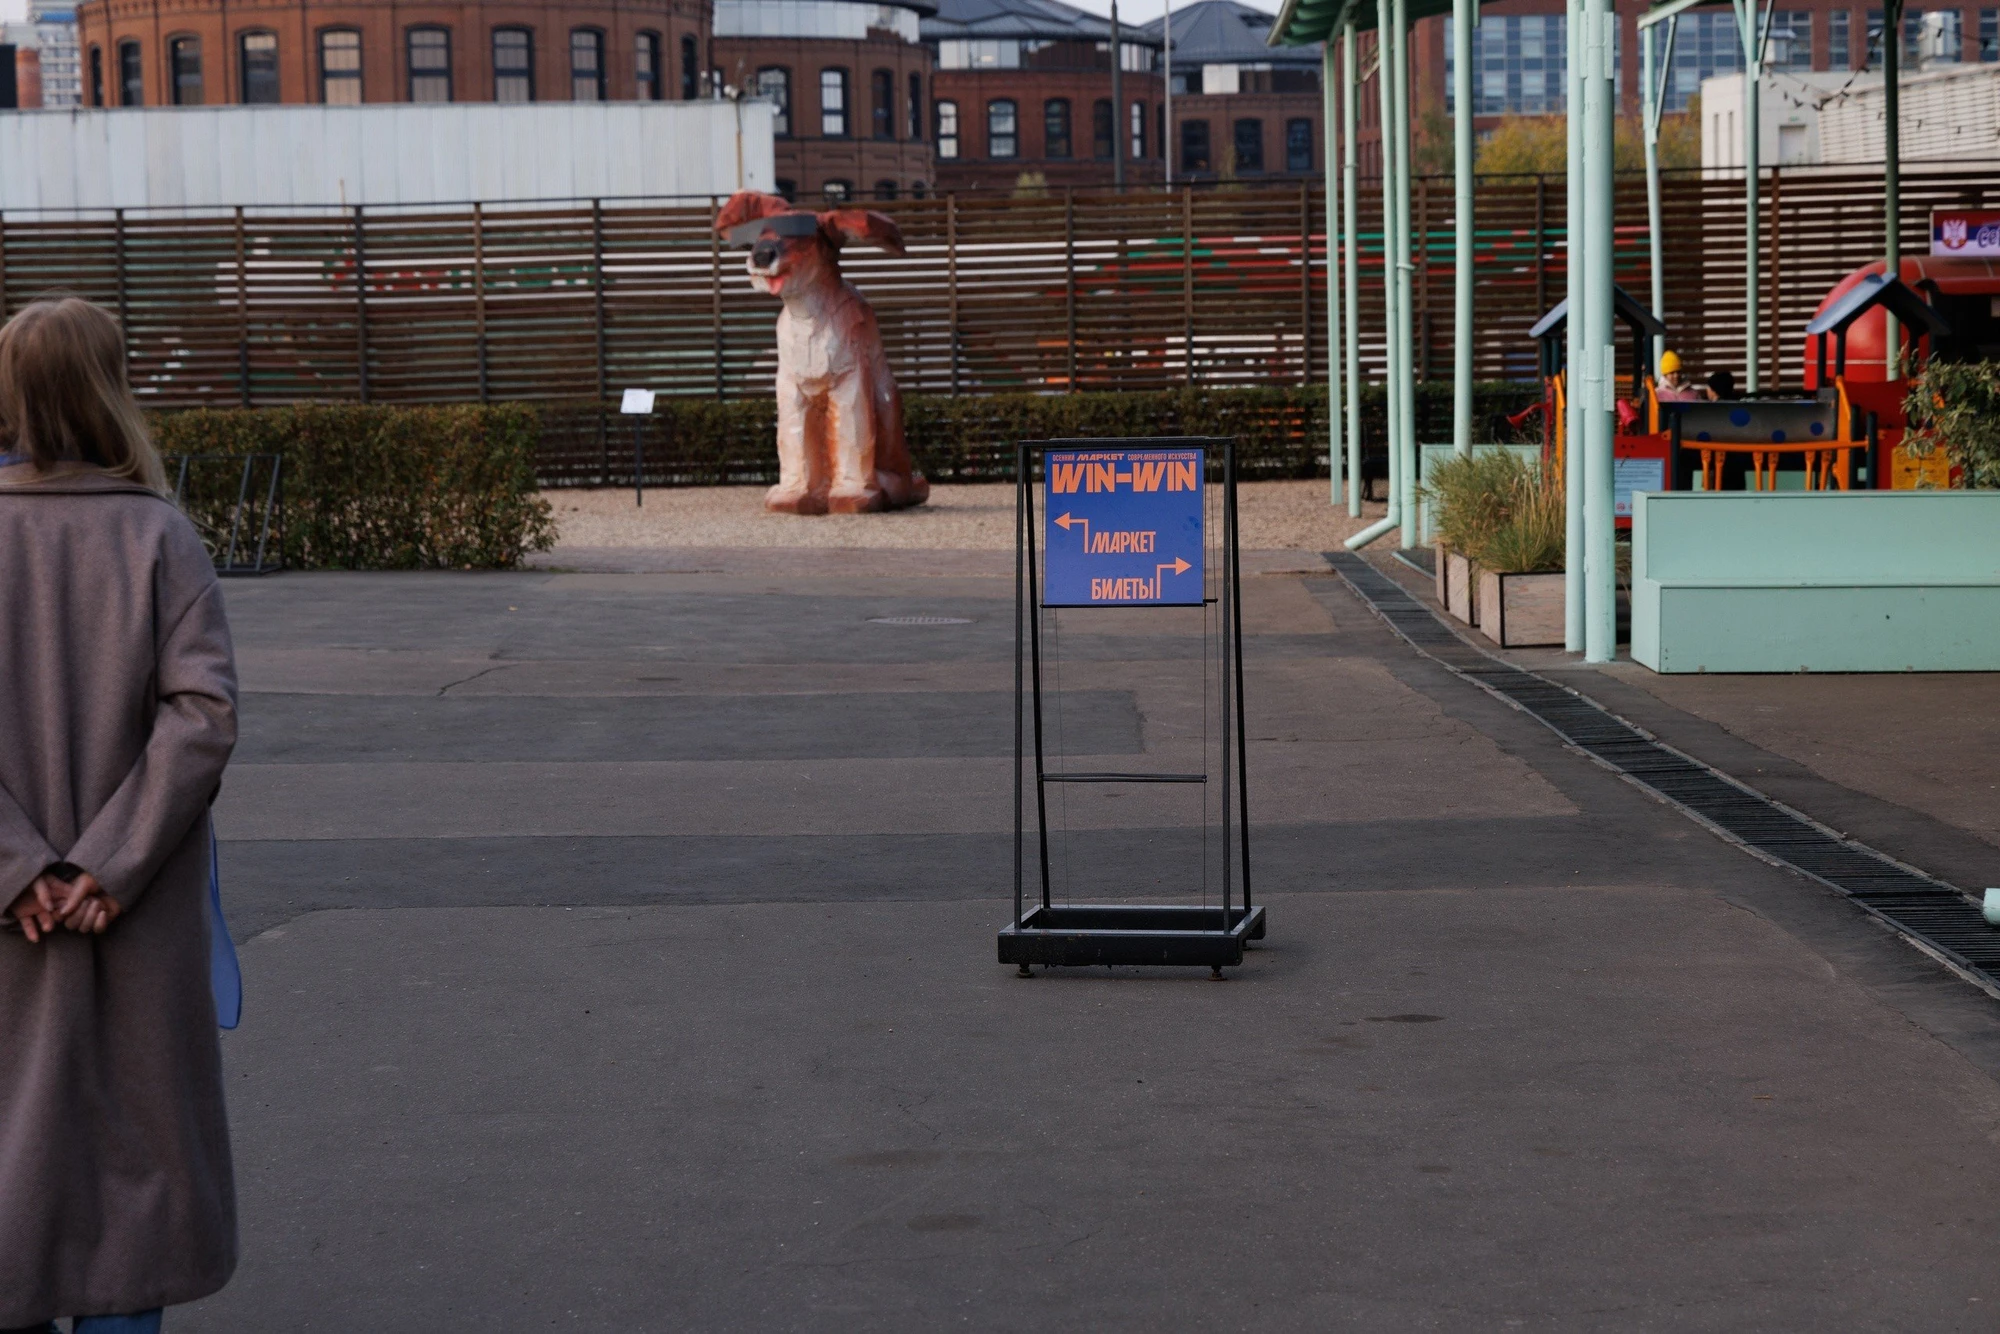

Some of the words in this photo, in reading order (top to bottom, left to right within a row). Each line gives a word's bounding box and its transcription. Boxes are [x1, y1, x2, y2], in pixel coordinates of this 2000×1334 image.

[1052, 461, 1196, 493] WIN-WIN
[1090, 531, 1156, 554] МАРКЕТ
[1091, 578, 1155, 600] БИЛЕТЫ
